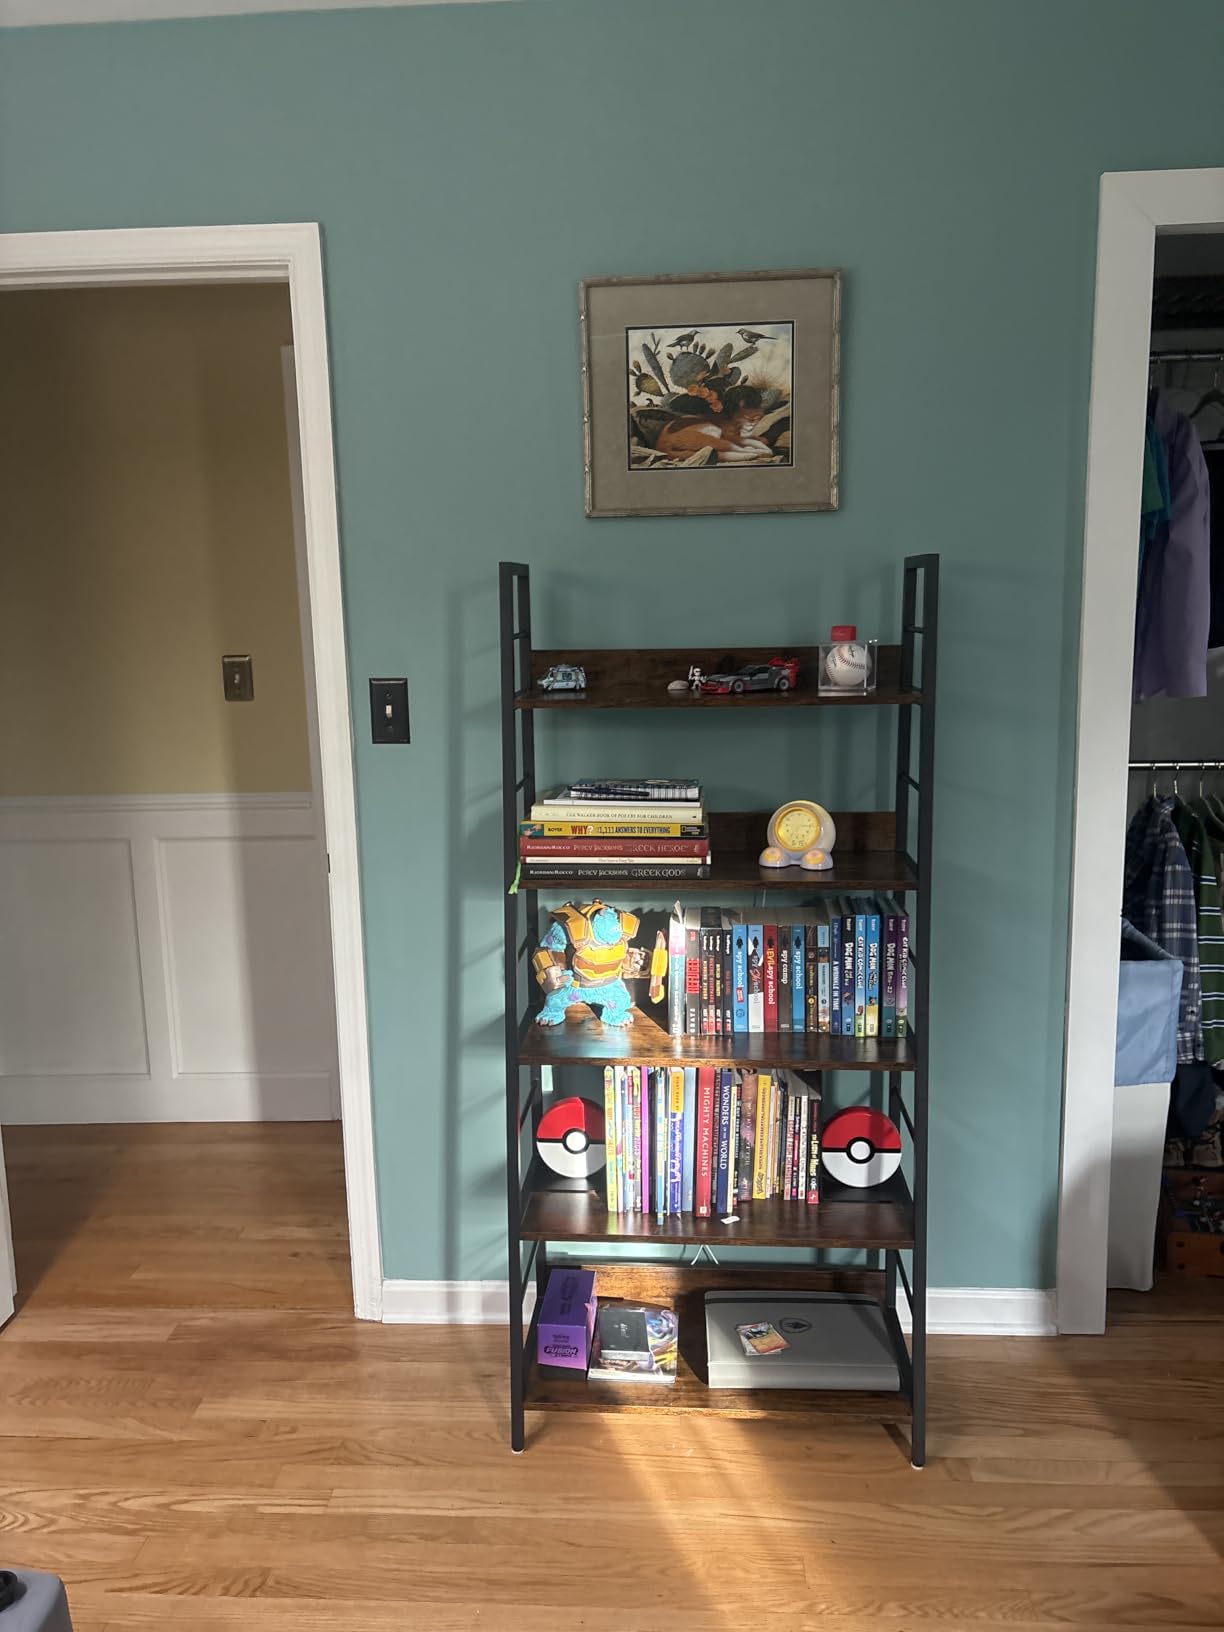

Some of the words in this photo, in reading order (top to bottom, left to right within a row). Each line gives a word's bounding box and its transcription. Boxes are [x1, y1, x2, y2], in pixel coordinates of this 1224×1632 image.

[570, 825, 594, 835] WHY?
[631, 868, 662, 878] GREEK
[844, 942, 854, 956] DOG
[869, 943, 878, 956] DOG
[886, 942, 896, 957] DOG
[780, 950, 788, 963] spy
[794, 951, 802, 965] spy
[844, 956, 854, 971] MAN
[869, 956, 878, 970] MAN
[886, 957, 895, 971] MAN
[780, 963, 788, 985] camp
[795, 965, 803, 989] school
[832, 966, 840, 990] WRINKLE
[832, 997, 840, 1011] TIME
[702, 1087, 711, 1125] MIGHTY
[721, 1085, 731, 1125] WONDERS
[701, 1127, 710, 1177] MACHINES
[719, 1139, 728, 1170] WORLD
[811, 1140, 820, 1155] LION
[545, 1346, 578, 1355] FUSION
